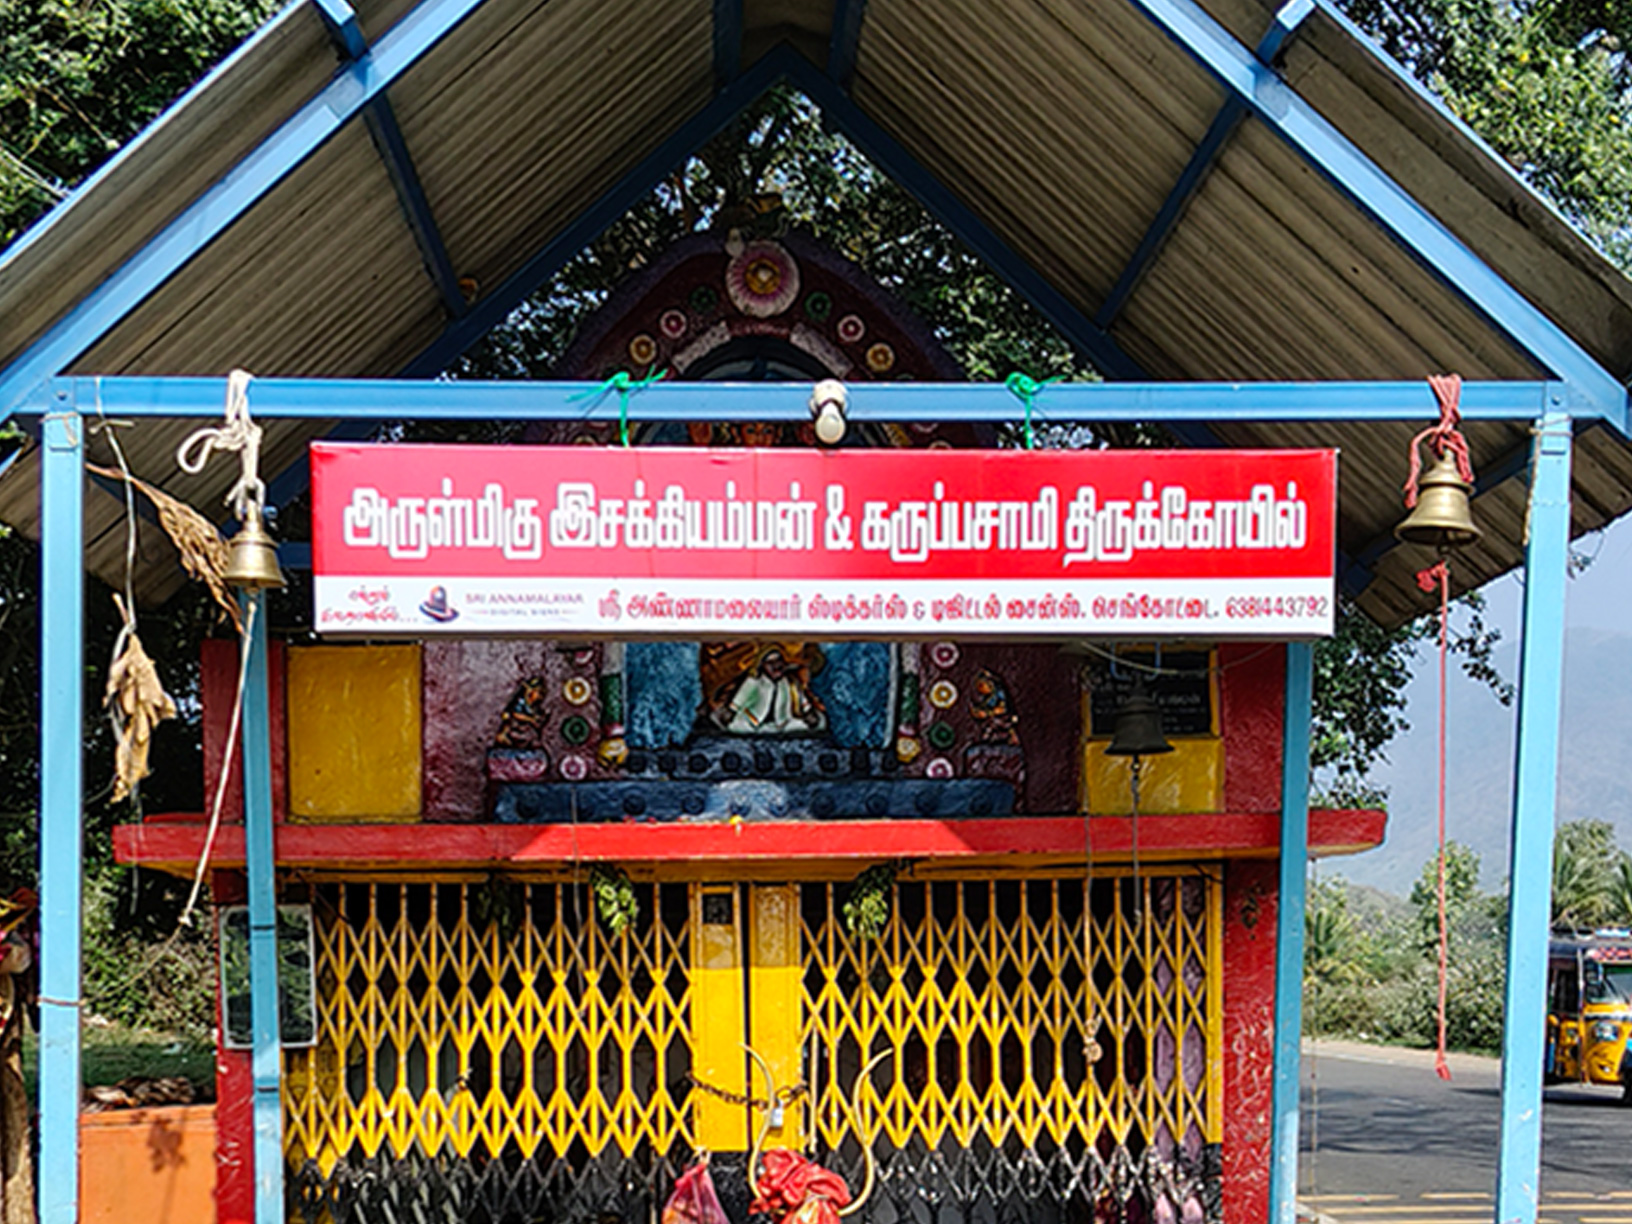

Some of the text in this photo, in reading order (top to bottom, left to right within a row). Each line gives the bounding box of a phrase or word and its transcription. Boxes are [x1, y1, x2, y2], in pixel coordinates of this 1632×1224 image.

[343, 477, 1307, 567] அருள்மிகு இசக்கியம்மன் & கருப்பசாமி திருக்கோயில்
[1225, 596, 1329, 619] 6381443792
